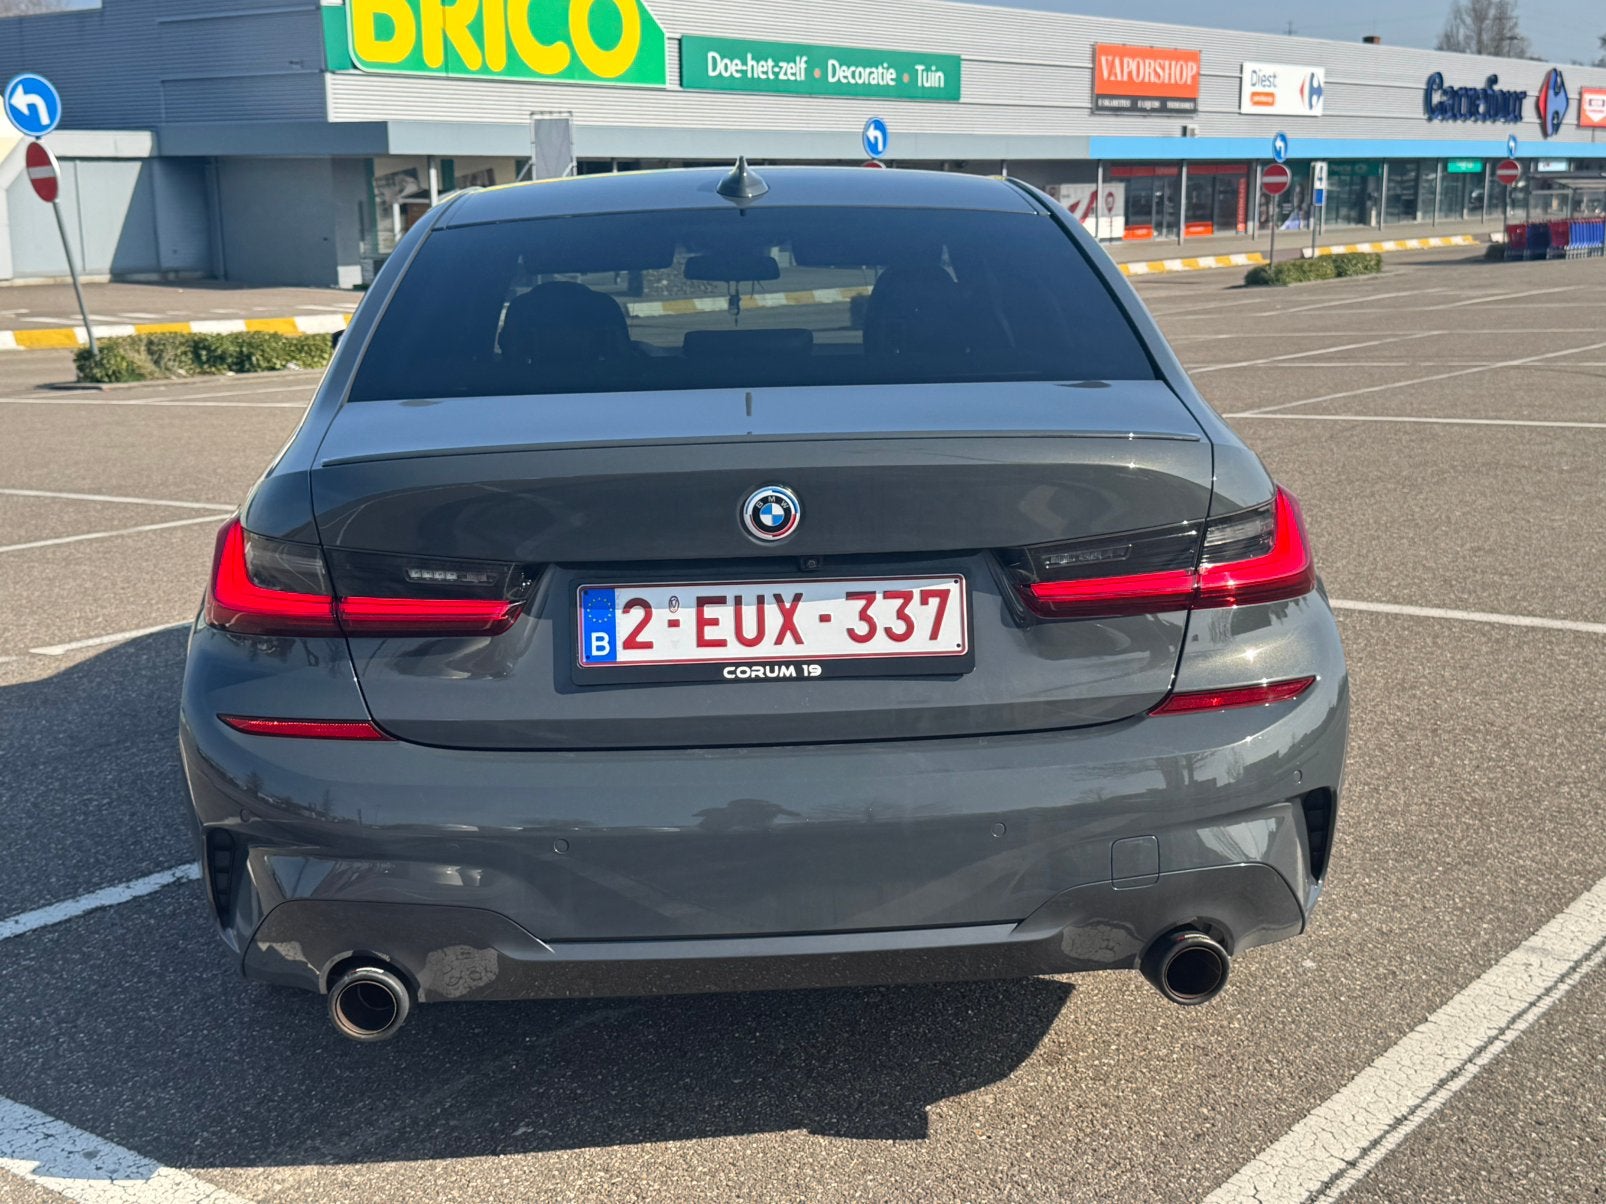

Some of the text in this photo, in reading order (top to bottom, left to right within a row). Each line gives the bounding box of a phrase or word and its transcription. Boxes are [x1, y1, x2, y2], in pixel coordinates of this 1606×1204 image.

[351, 0, 641, 78] BRICO
[707, 51, 945, 88] Doe-het-zelf Decoratie Tuin
[1100, 55, 1197, 85] VAPORSHOP
[1250, 69, 1278, 88] Diest
[755, 495, 790, 509] BMW
[591, 632, 611, 657] B
[722, 664, 823, 679] CORUM 19
